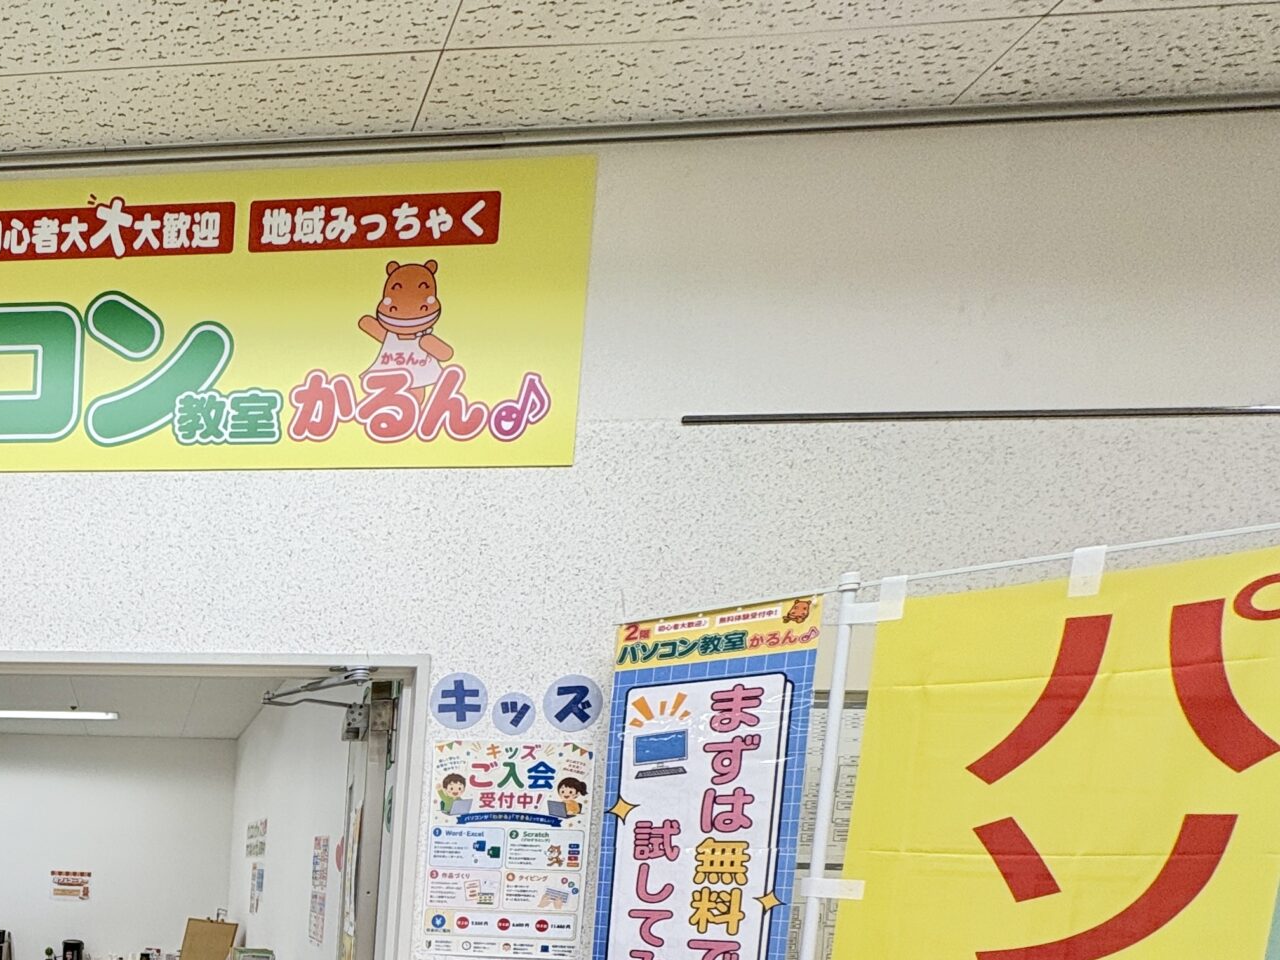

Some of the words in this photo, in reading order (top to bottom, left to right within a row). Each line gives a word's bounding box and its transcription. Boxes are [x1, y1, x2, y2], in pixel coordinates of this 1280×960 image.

[260, 202, 489, 245] 地域みっちゃく
[172, 390, 282, 443] 教室
[617, 630, 748, 665] パソコン教室
[749, 630, 797, 648] かるん
[438, 679, 592, 727] キッズ
[486, 744, 541, 760] キッズ
[470, 761, 556, 789] ご入会
